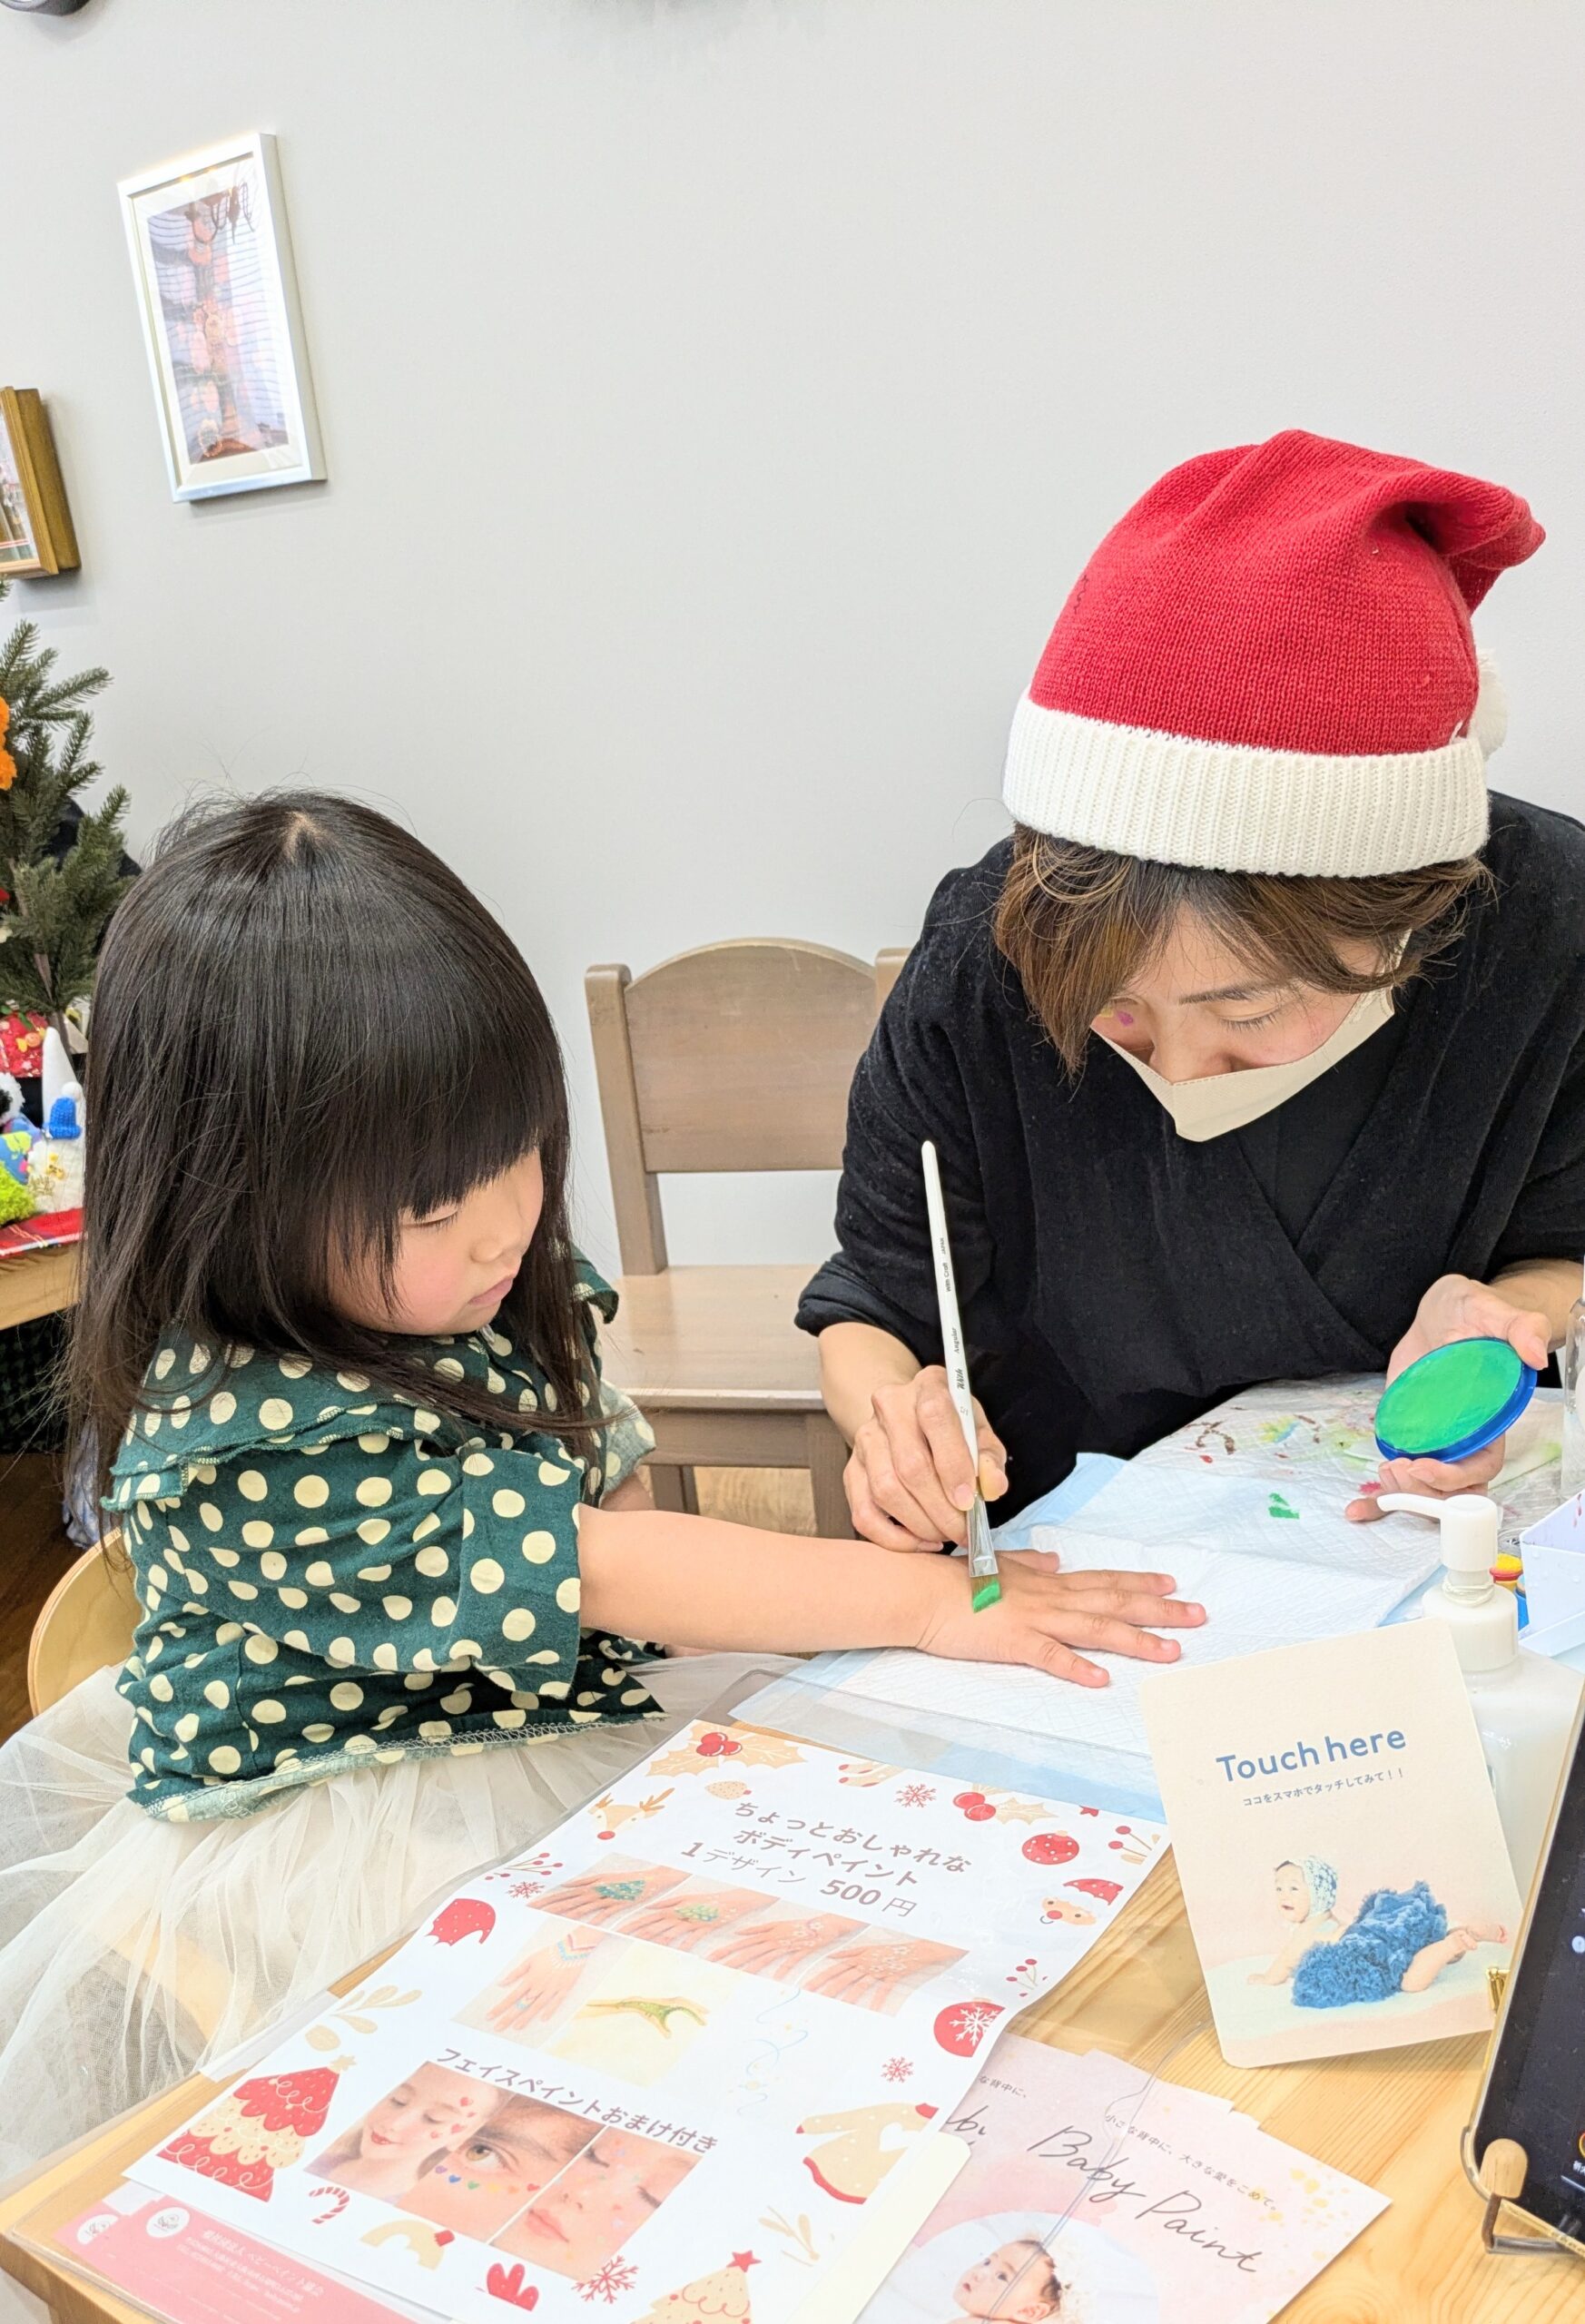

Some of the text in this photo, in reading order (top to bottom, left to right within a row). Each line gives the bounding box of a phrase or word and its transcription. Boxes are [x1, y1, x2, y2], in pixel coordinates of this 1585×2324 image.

[951, 1327, 960, 1354] Angular
[1216, 1729, 1406, 1782] Touch here
[1243, 1768, 1403, 1806] ココをスマホでタッチしてみて！！
[681, 1841, 806, 1885] 1デザイン
[733, 1802, 972, 1873] ちょっとおしゃれな
[733, 1829, 918, 1886] ボディペイント
[437, 2047, 718, 2154] フェイスペイントおまけ付き
[1026, 2124, 1147, 2203] Baby
[1135, 2189, 1263, 2273] Paint
